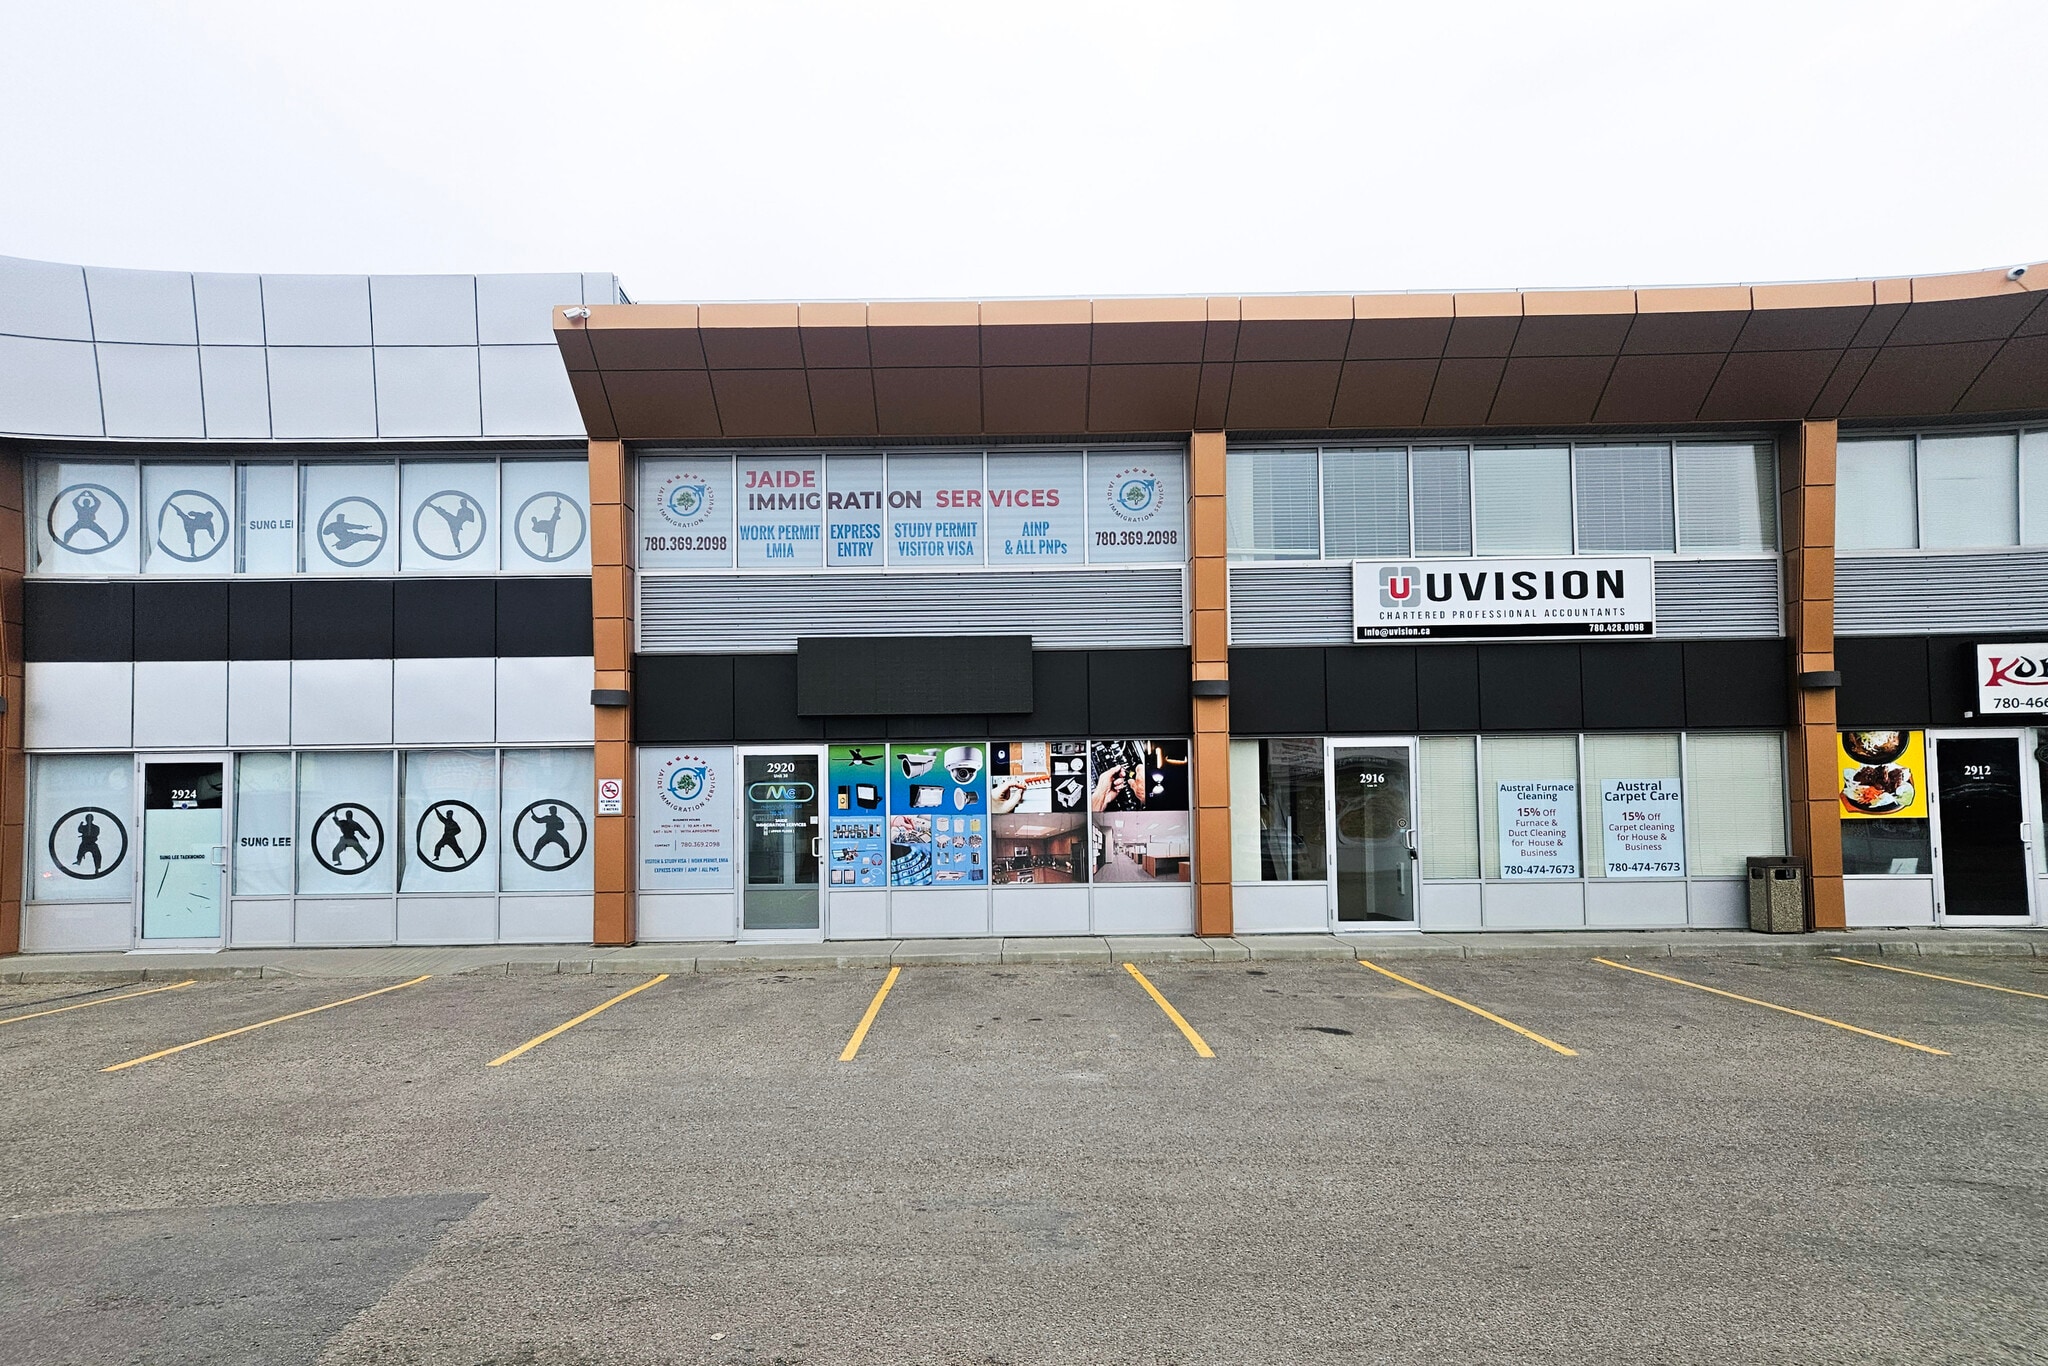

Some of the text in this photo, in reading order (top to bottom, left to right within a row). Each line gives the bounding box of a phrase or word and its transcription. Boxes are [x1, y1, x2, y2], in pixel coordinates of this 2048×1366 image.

[745, 470, 816, 488] JAIDE
[749, 489, 1060, 511] IMMIGRATION SERVICES
[1107, 480, 1164, 522] JAIDE IMMIGRATION SERVICES
[657, 486, 715, 528] JAIDE IMMIGRATION SERVICES
[250, 520, 276, 529] SUNG
[830, 523, 881, 539] EXPRESS
[894, 521, 978, 538] STUDY PERMIT
[1021, 521, 1050, 537] AINP
[740, 524, 820, 540] WORK PERMIT
[1095, 530, 1178, 546] 780.369.2098
[644, 536, 727, 551] 780.369.2098
[766, 542, 795, 558] LMIA
[837, 541, 874, 557] ENTRY
[898, 540, 974, 556] VISITOR VISA
[1005, 539, 1068, 555] & ALL PNPs
[1426, 570, 1624, 602] UVISION
[1379, 607, 1626, 620] CHARTERED PROFESSIONAL ACCOUNTANTS
[1589, 623, 1644, 632] 780.428.0098
[766, 762, 795, 773] 2920
[1964, 765, 1991, 775] 2912
[1360, 773, 1384, 783] 2916
[657, 768, 716, 812] JAIDE IMMIGRATION SERVICES
[1500, 784, 1533, 792] Austral
[1616, 781, 1662, 791] Austral
[171, 789, 197, 799] 2924
[1517, 792, 1558, 802] Cleaning
[1605, 791, 1679, 804] Carpet Care
[1517, 808, 1540, 817] 15%
[1622, 812, 1645, 820] 15%
[1530, 829, 1566, 838] Cleaning
[1609, 823, 1675, 832] Carpet cleaning
[241, 837, 291, 847] SUNG LEE
[1617, 833, 1629, 841] for
[1504, 865, 1575, 874] 780-474-7673
[1608, 863, 1680, 872] 780-474-7673
